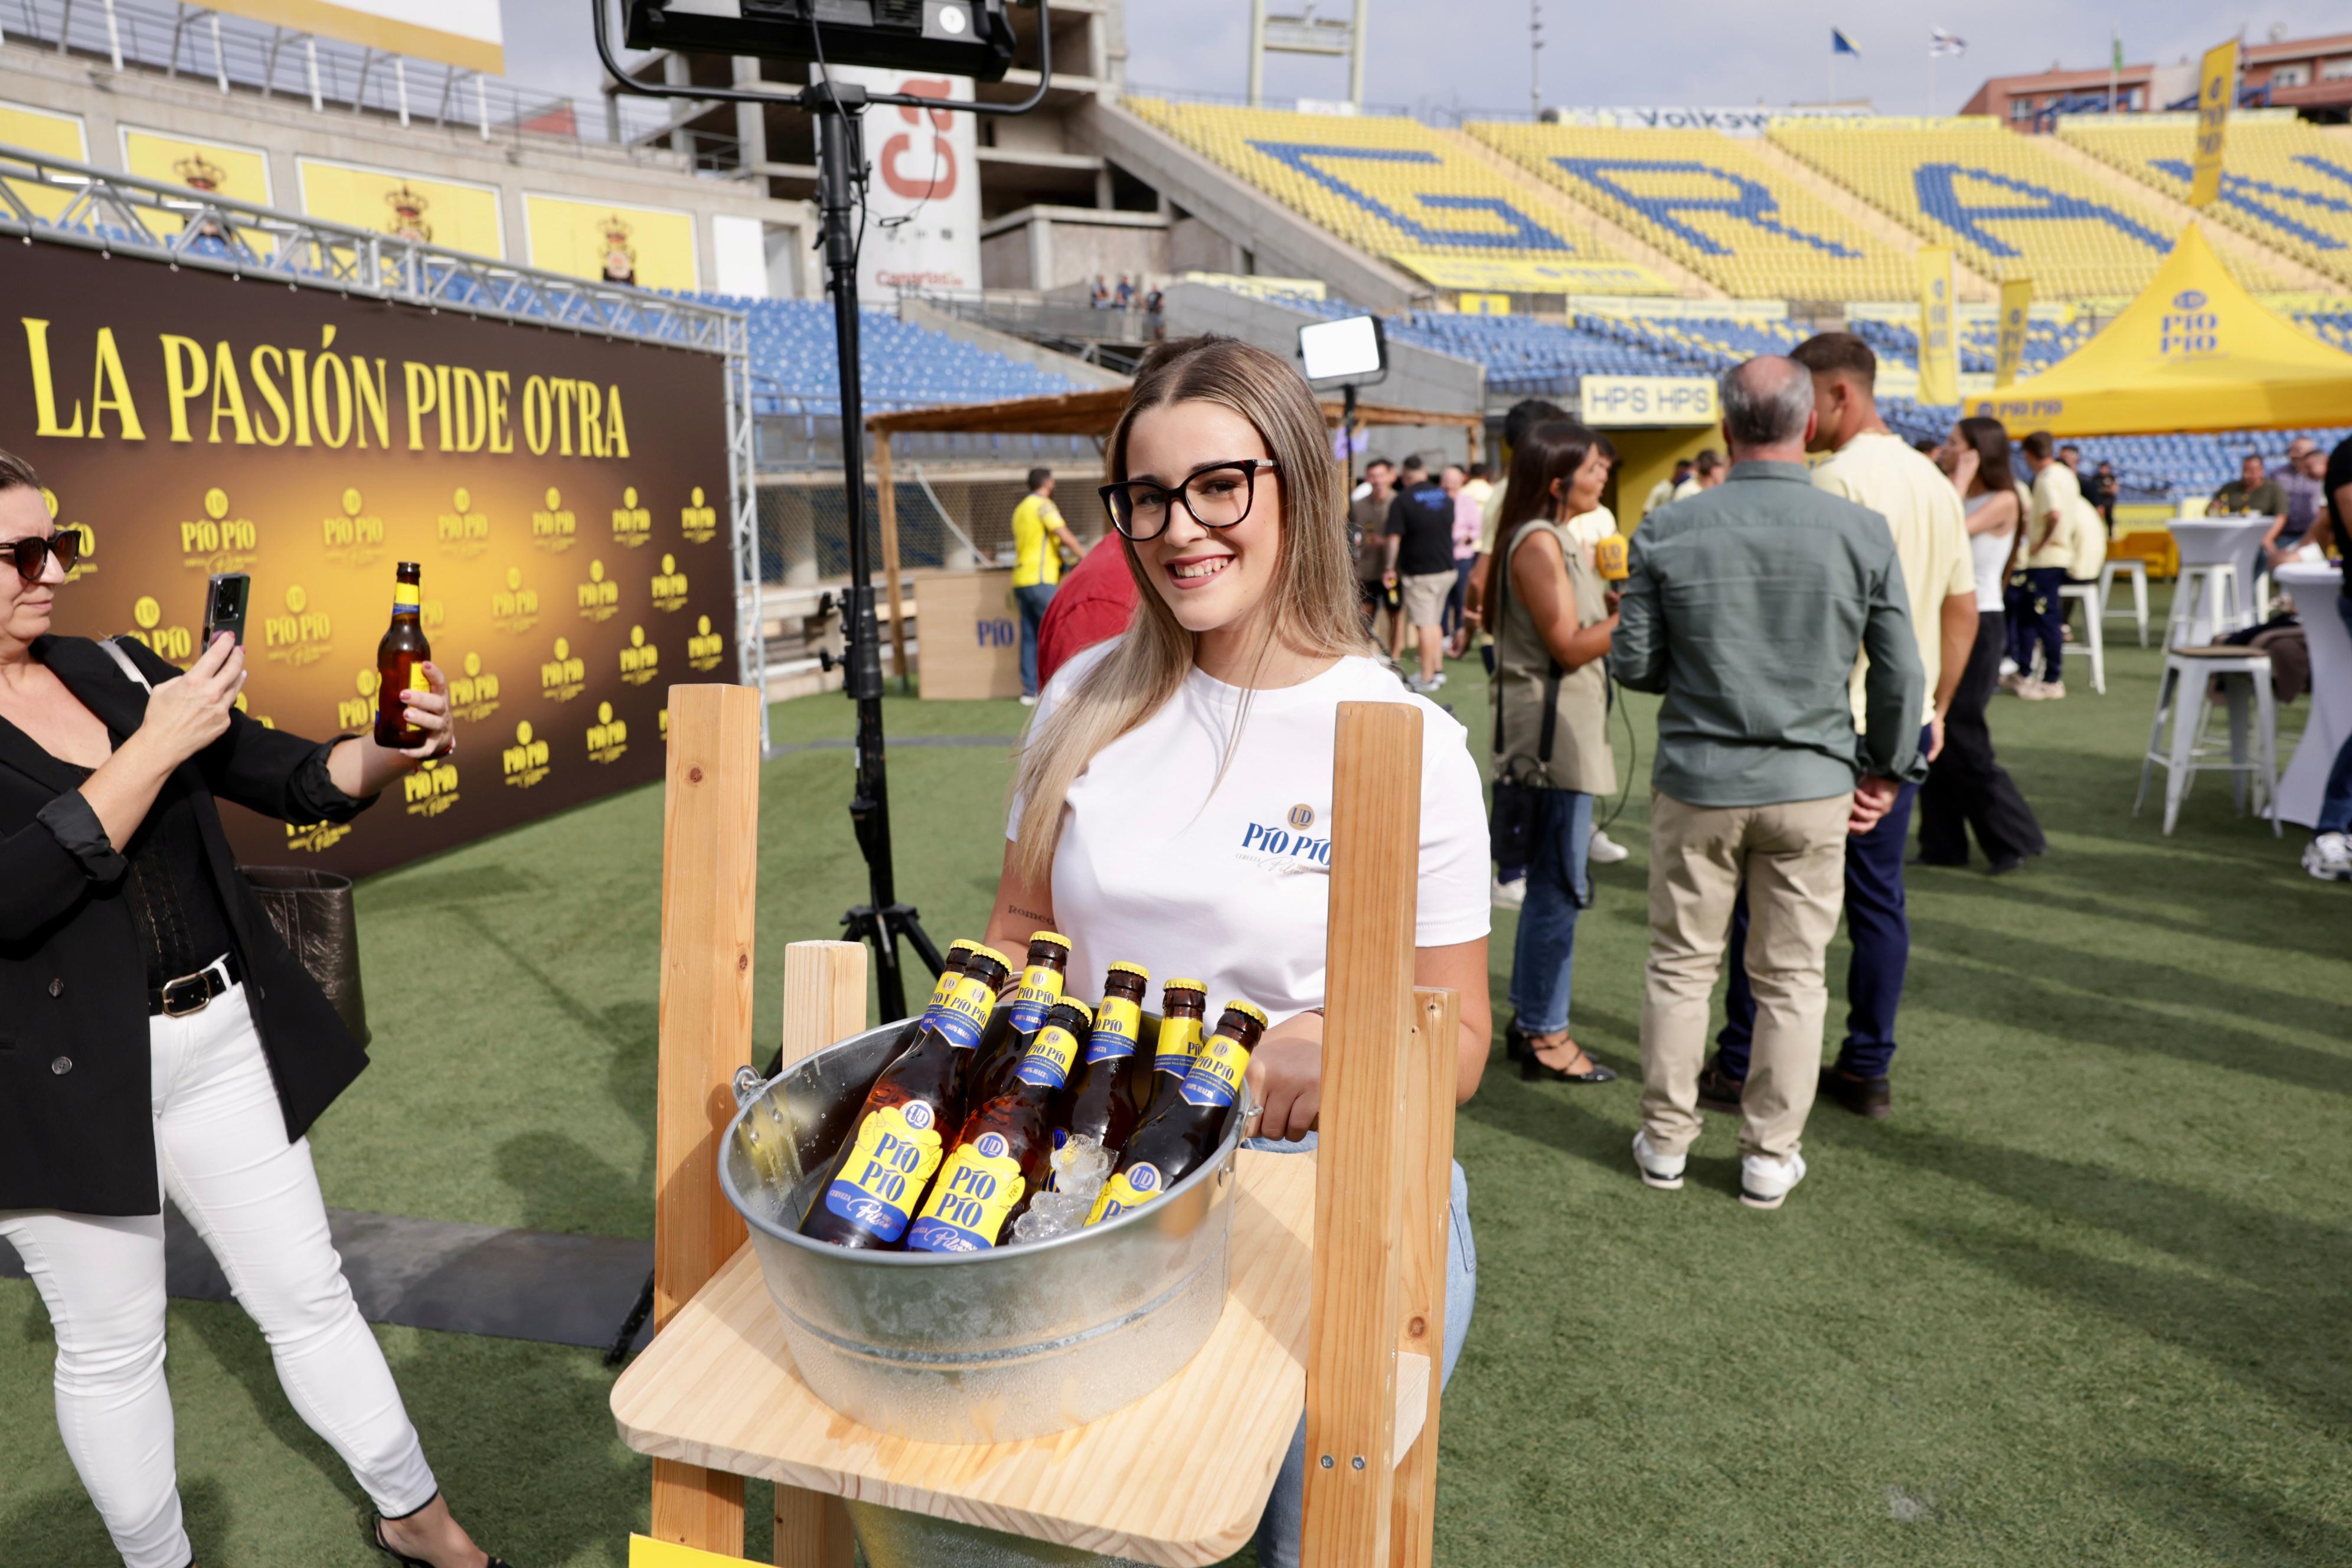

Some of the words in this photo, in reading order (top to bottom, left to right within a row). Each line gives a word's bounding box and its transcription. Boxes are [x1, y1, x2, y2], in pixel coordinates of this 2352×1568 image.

[21, 316, 147, 441] LA
[159, 324, 390, 449] PASIÓN
[403, 361, 514, 454] PIDE
[522, 375, 631, 459] OTRA
[1590, 386, 1648, 413] HPS
[1655, 387, 1710, 414] HPS
[978, 618, 1014, 647] PÍO
[1291, 807, 1312, 827] UD
[1242, 822, 1289, 854] PÍO
[1017, 987, 1034, 999] PÍO
[1035, 989, 1054, 1005] PÍO
[950, 998, 971, 1012] PÍO
[971, 1005, 987, 1025] PÍO
[1102, 1019, 1123, 1033] PÍO
[1027, 1044, 1046, 1055] PÍO
[1046, 1047, 1066, 1065] PÍO
[1194, 1056, 1213, 1069] PÍO
[1213, 1061, 1234, 1081] PÍO
[906, 1105, 929, 1128] UD
[873, 1132, 920, 1174] PÍO
[980, 1137, 1002, 1156] UD
[858, 1161, 906, 1202] PÍO
[949, 1166, 997, 1200] PÍO
[1131, 1168, 1154, 1190] UD
[829, 1190, 852, 1203] CERVEZA
[847, 1198, 890, 1229] Pilsen
[935, 1193, 983, 1228] PÍO
